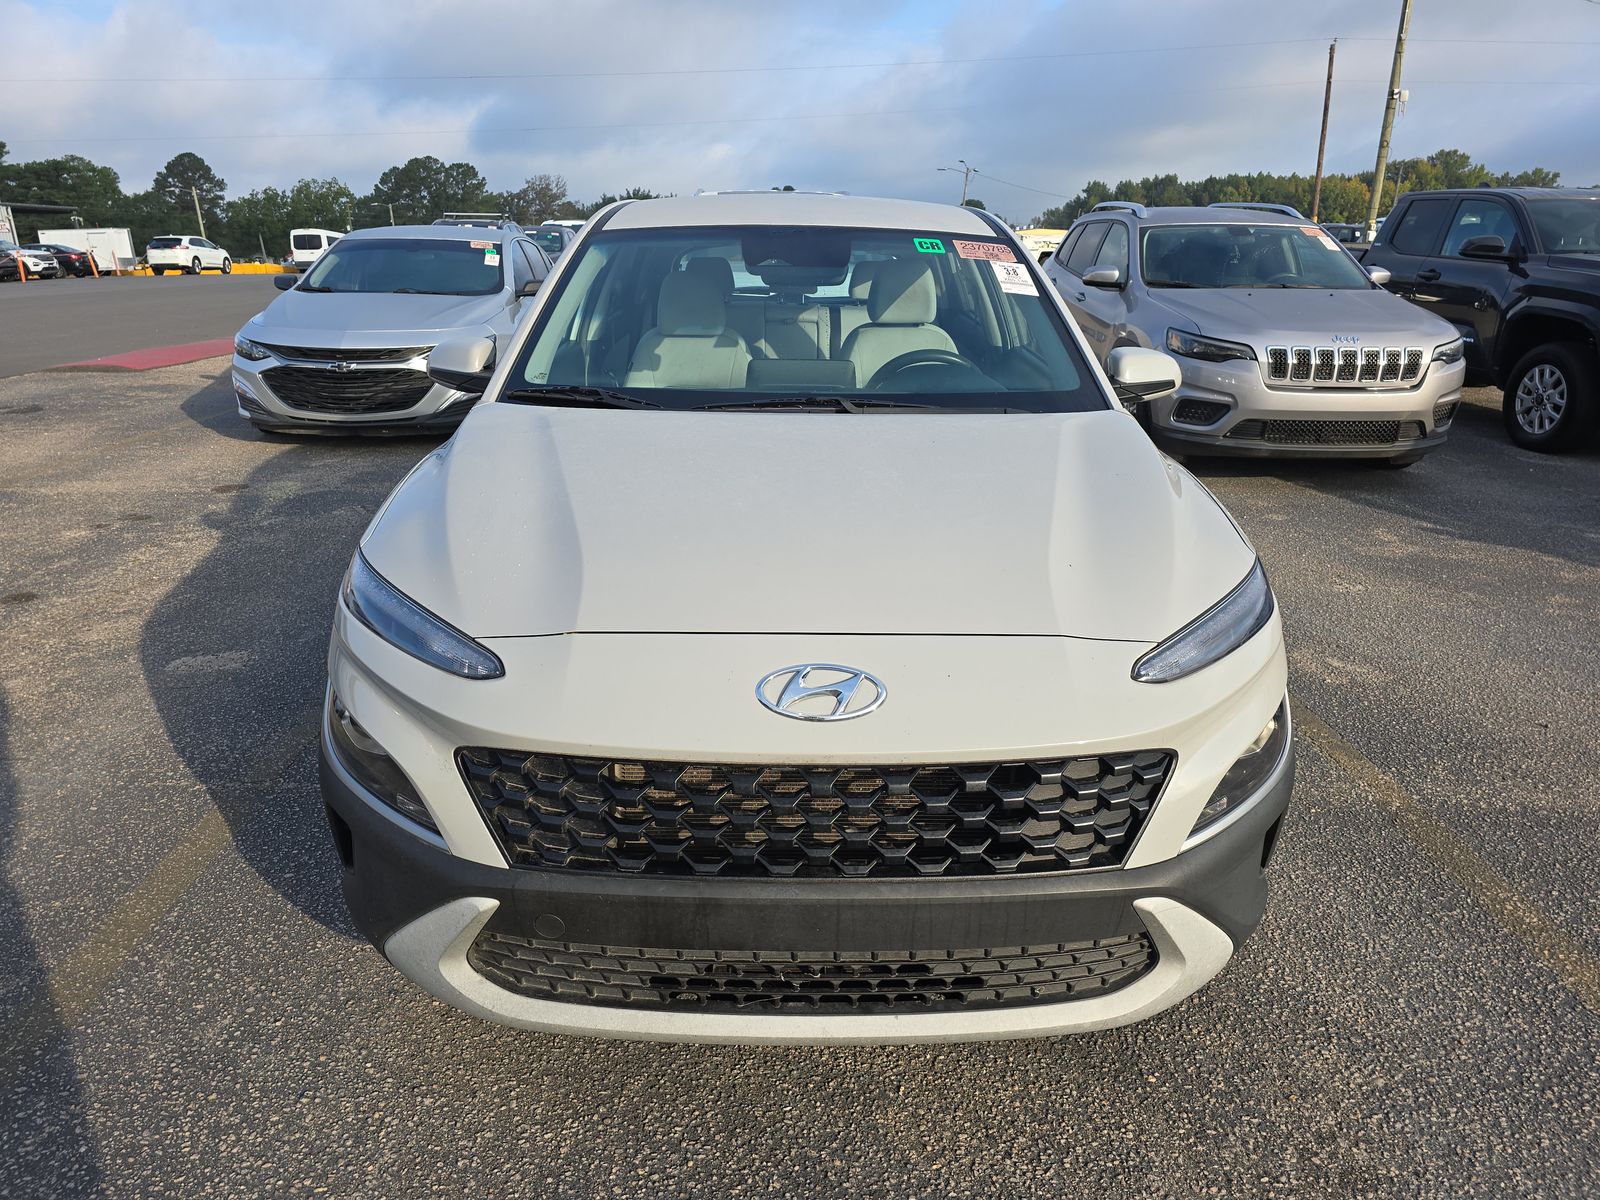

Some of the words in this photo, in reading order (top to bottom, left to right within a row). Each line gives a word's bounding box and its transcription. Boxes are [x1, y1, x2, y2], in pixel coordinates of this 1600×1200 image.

[918, 241, 942, 250] CR
[960, 242, 1012, 254] 2370785
[1331, 335, 1360, 344] Jeep
